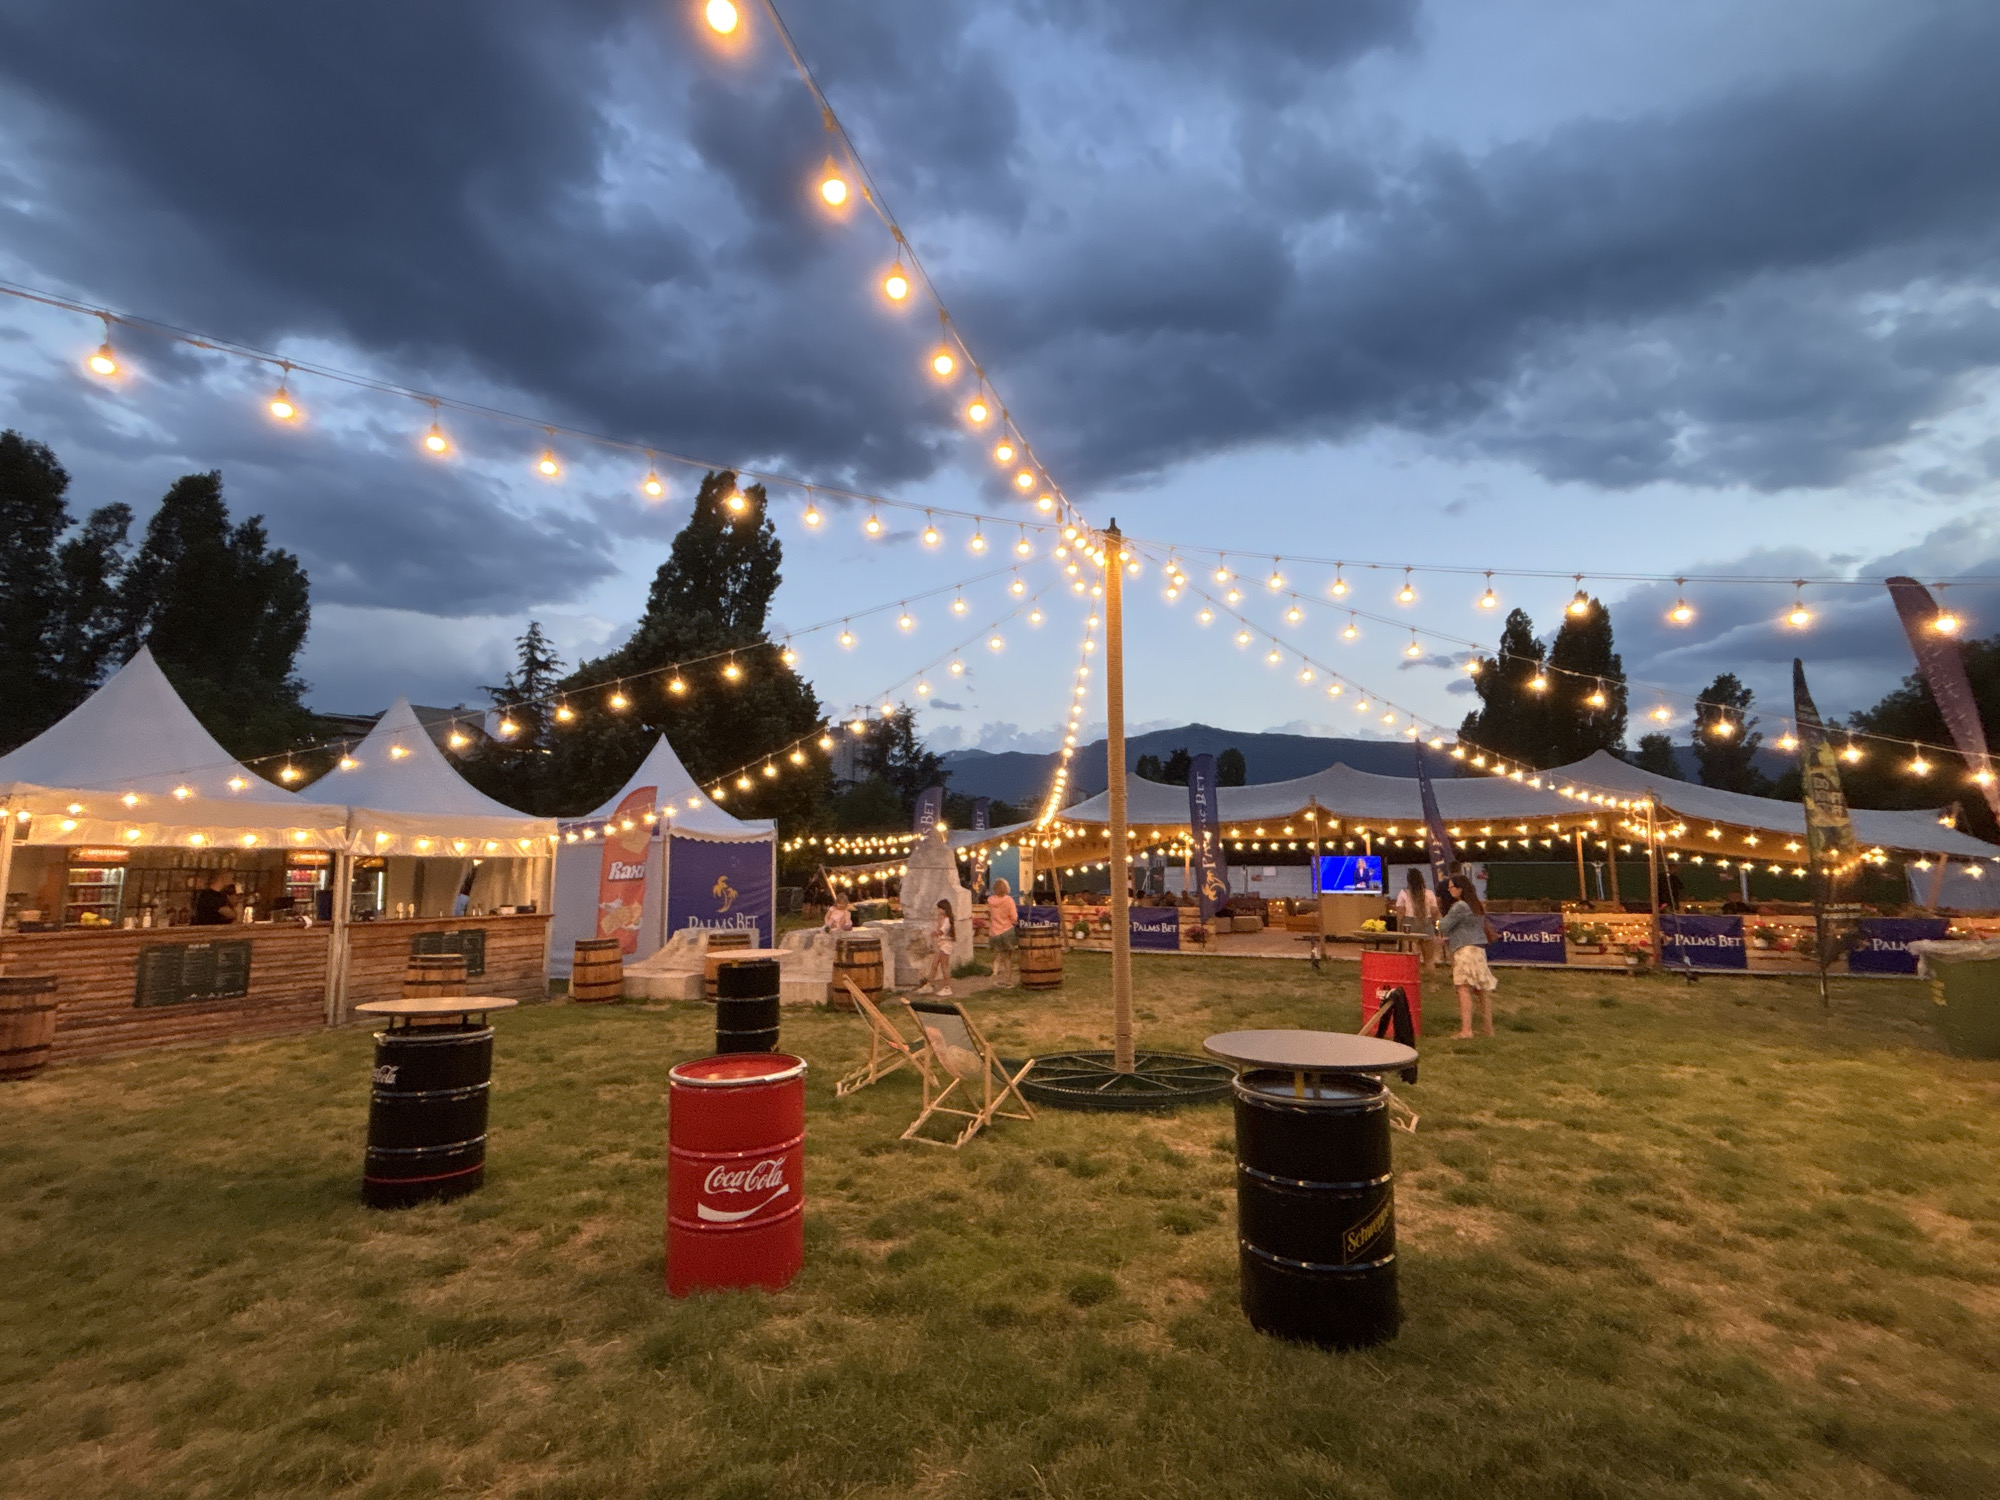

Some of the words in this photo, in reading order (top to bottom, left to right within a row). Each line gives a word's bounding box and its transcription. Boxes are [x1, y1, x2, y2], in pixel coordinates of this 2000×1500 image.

[920, 800, 934, 826] BET
[736, 912, 758, 929] BET
[1133, 921, 1160, 932] PALMS
[1161, 922, 1177, 933] BET
[1503, 930, 1540, 943] PALMS
[1541, 931, 1562, 943] BET
[1674, 933, 1716, 947] PALMS
[1718, 934, 1741, 947] BET
[704, 1156, 787, 1194] Coca-Cola
